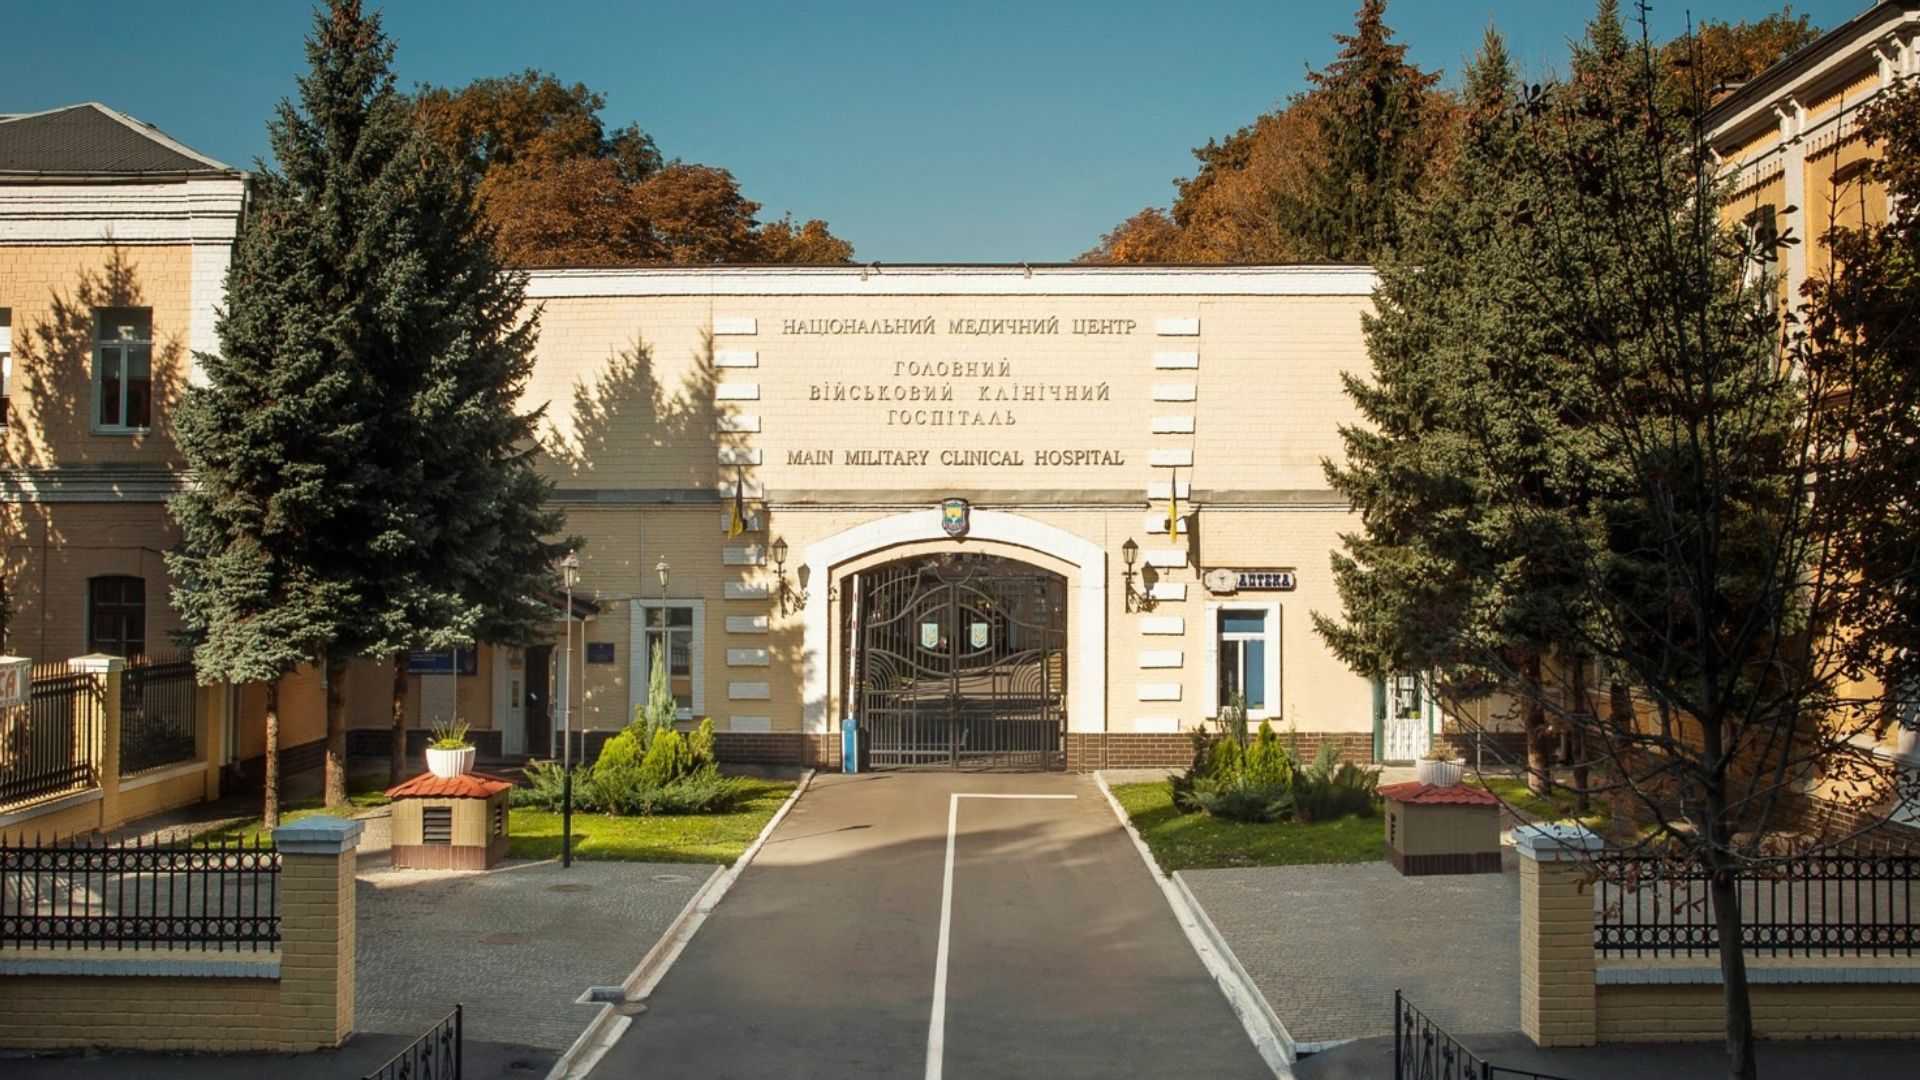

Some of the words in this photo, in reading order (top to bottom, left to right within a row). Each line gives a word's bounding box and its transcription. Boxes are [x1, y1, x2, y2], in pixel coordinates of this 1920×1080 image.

[782, 316, 935, 335] НАЦІОНАЛЬНИЙ
[948, 316, 1059, 335] МЕДИЧНИЙ
[1072, 319, 1137, 335] ЦЕНТР
[894, 358, 1011, 377] ГОЛОВНИЙ
[809, 382, 953, 401] ВІЙСЬКОВИЙ
[978, 382, 1110, 401] КЛІНІЧНИЙ
[887, 410, 1016, 427] ГОСПІТАЛЬ
[787, 450, 833, 466] MAIN
[845, 450, 929, 466] MILITARY
[940, 450, 1024, 466] CLINICAL
[1034, 450, 1125, 466] HOSPITAL
[1239, 574, 1290, 587] АПТЕКА
